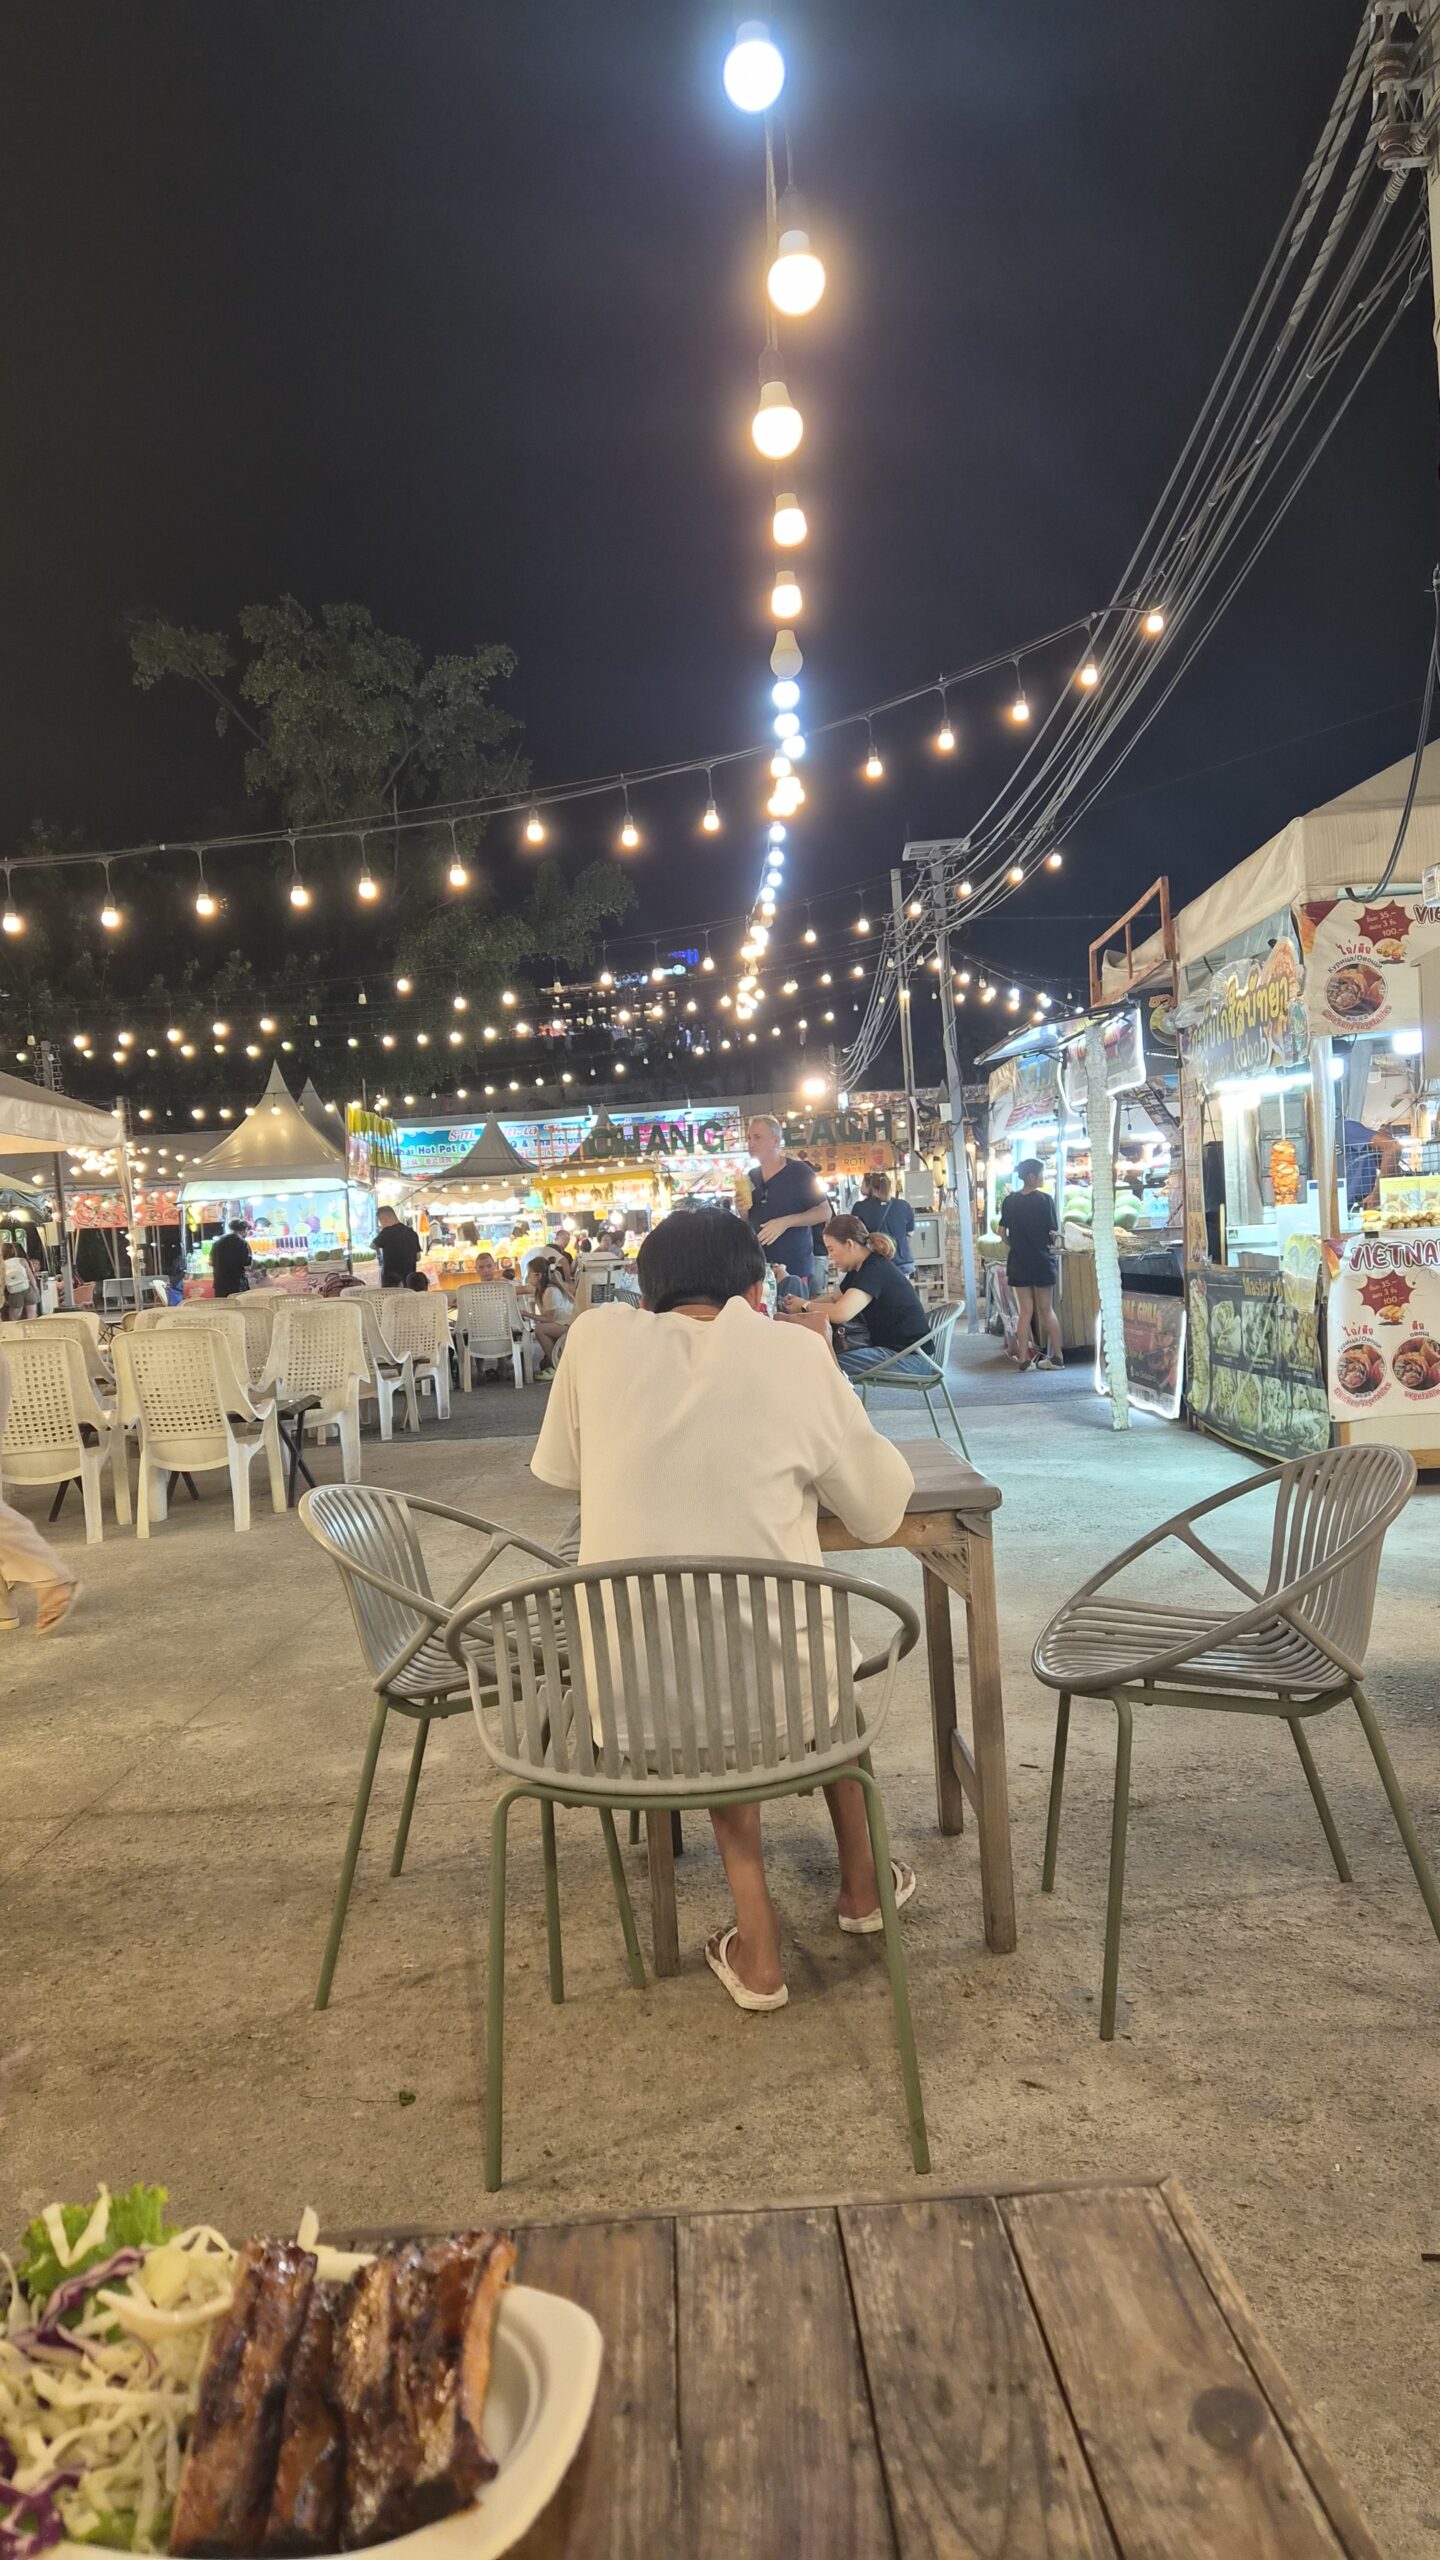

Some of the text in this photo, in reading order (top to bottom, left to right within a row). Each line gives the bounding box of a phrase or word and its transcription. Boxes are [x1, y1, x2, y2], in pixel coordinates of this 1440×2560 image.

[782, 1108, 892, 1148] EACH
[418, 1146, 435, 1154] Hot
[439, 1144, 457, 1153] Pot
[460, 1143, 467, 1152] &
[522, 1139, 528, 1147] &
[843, 1157, 866, 1167] ROTI
[1350, 1239, 1440, 1271] VIETNA
